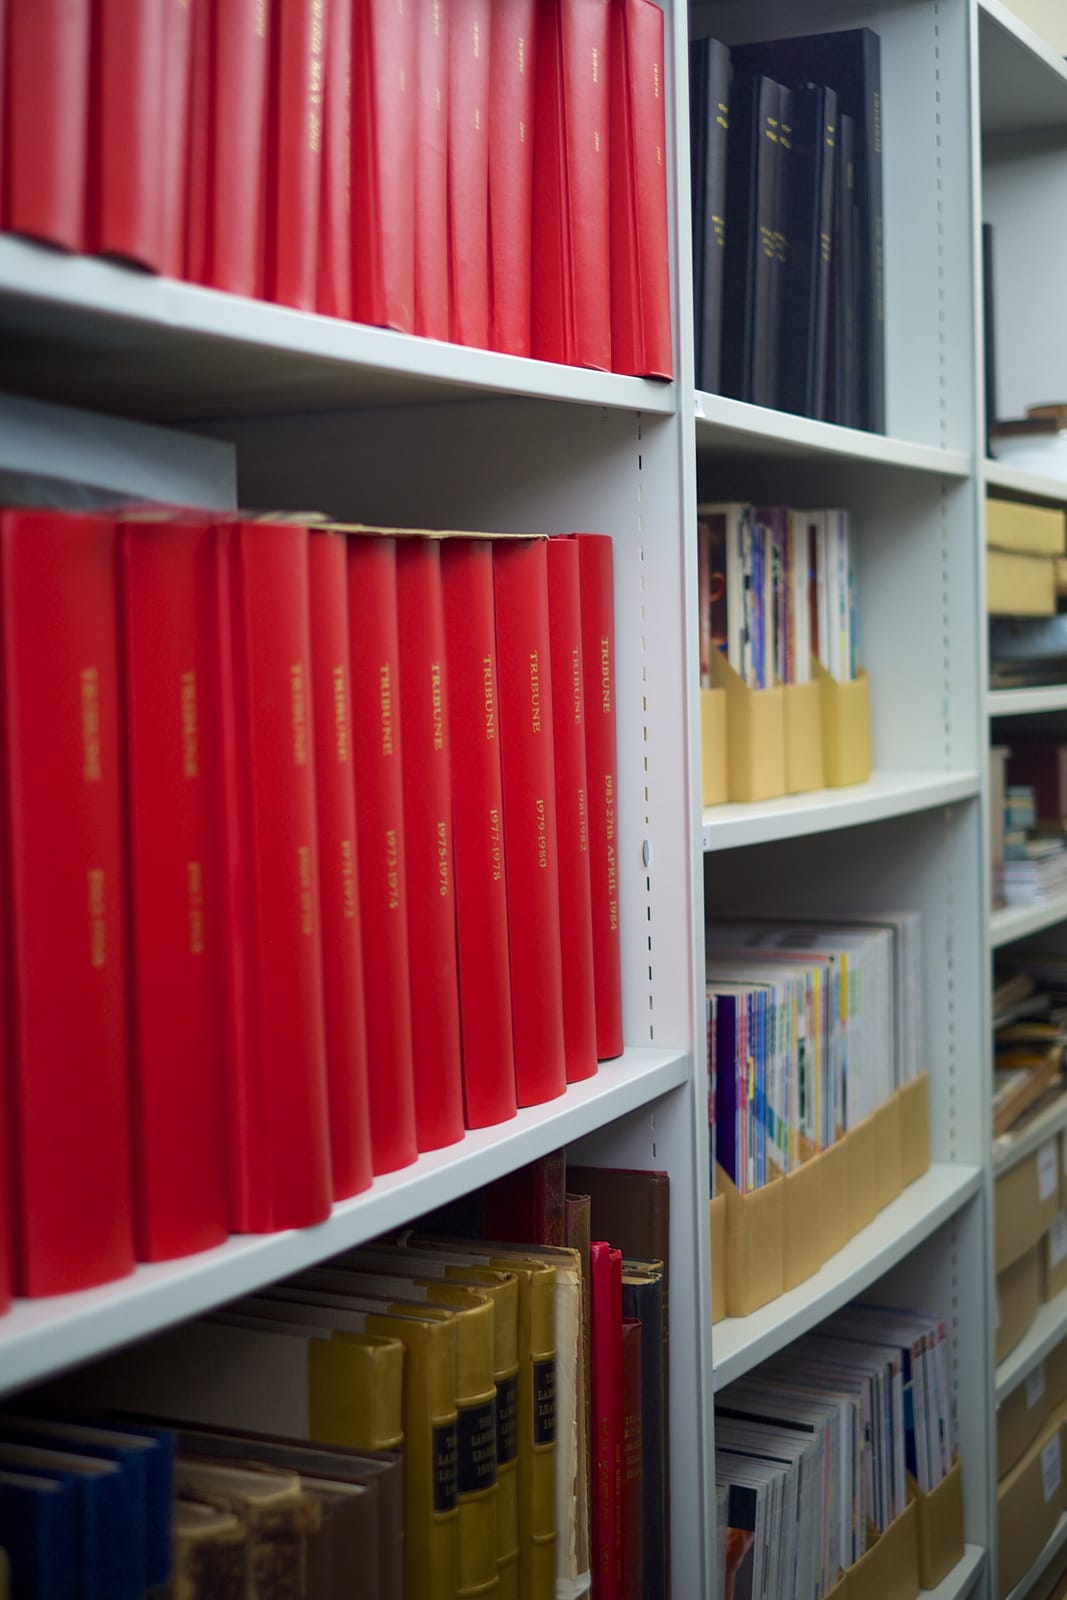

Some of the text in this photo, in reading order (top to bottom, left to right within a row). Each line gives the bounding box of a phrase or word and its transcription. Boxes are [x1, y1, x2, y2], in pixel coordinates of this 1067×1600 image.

[334, 665, 348, 763] TRIBUNE
[379, 662, 399, 909] TRIBUNE 1973-1974
[431, 662, 449, 897] TRIBUNE 1975-1976
[482, 655, 500, 881] TRIBUNE 1977-1978
[530, 650, 547, 869] TRIBUNE 1979-1980
[571, 648, 587, 853] TRIBUNE 1981-1982
[600, 637, 618, 931] TRIBUNE 1983-27th APRIL 1984
